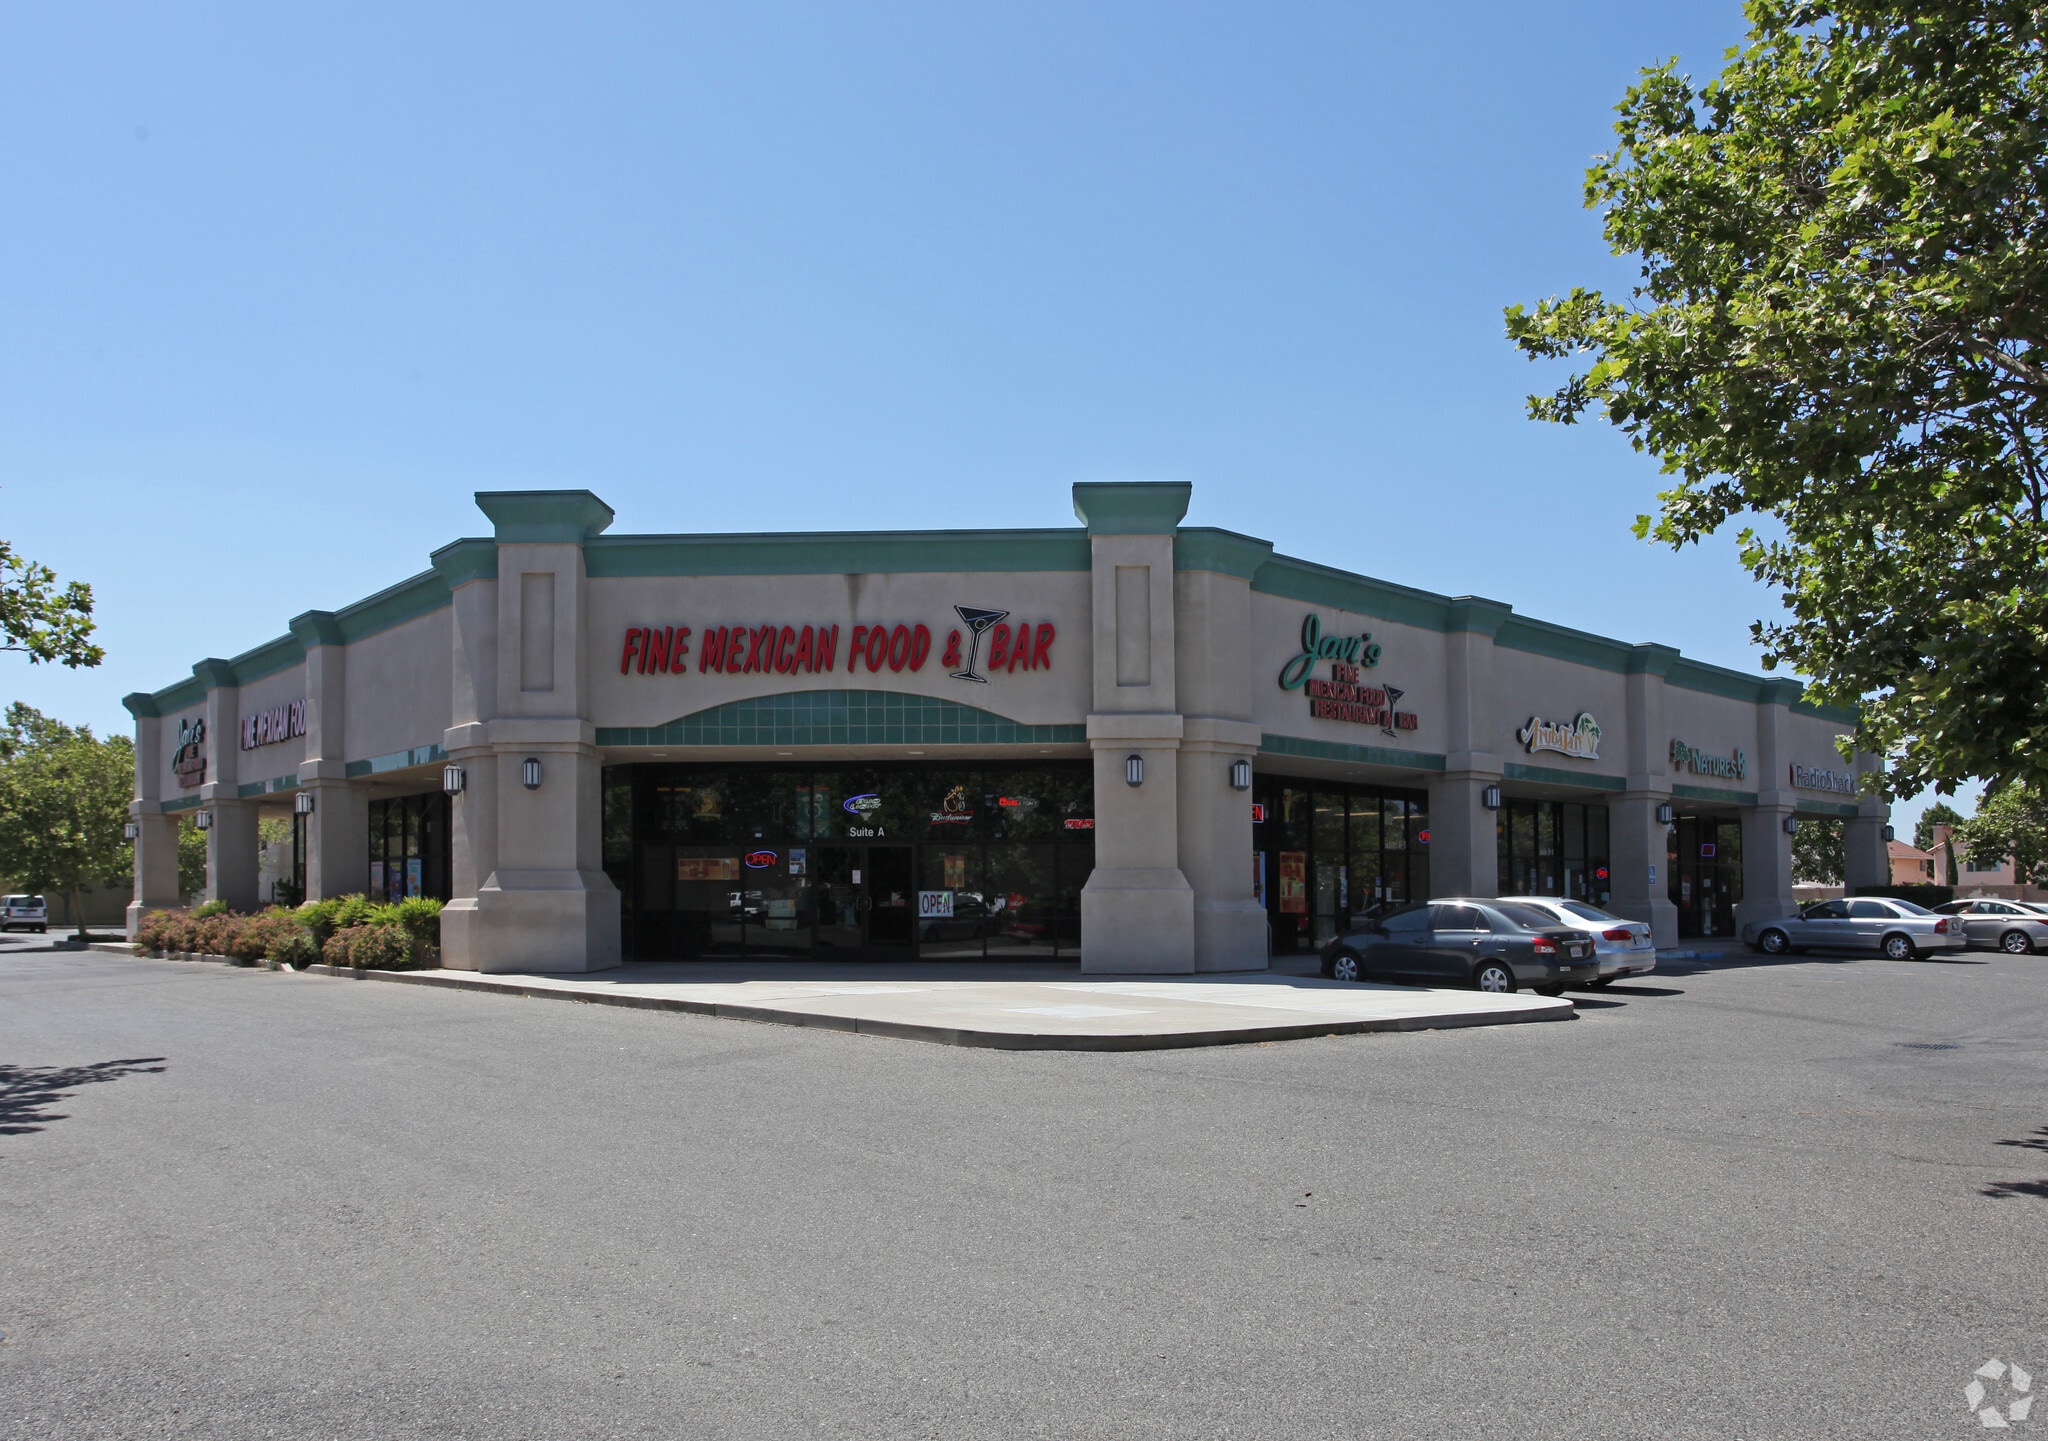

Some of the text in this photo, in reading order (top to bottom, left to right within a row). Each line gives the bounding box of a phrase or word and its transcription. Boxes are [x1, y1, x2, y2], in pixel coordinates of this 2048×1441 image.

[620, 622, 1056, 676] FINE MEXICAN FOOD & BAR
[1278, 613, 1382, 691] Javi's
[1333, 664, 1360, 684] FINE
[1306, 679, 1386, 706] MEXICAN FOOD
[256, 704, 289, 746] MEXICAN
[290, 699, 306, 738] FOO
[1311, 700, 1380, 725] RESTAURANT
[1396, 711, 1418, 730] BAR
[1796, 764, 1856, 794] RadioShack
[850, 827, 885, 837] Suite A
[745, 853, 776, 865] OPEN
[922, 894, 950, 914] OPEN
